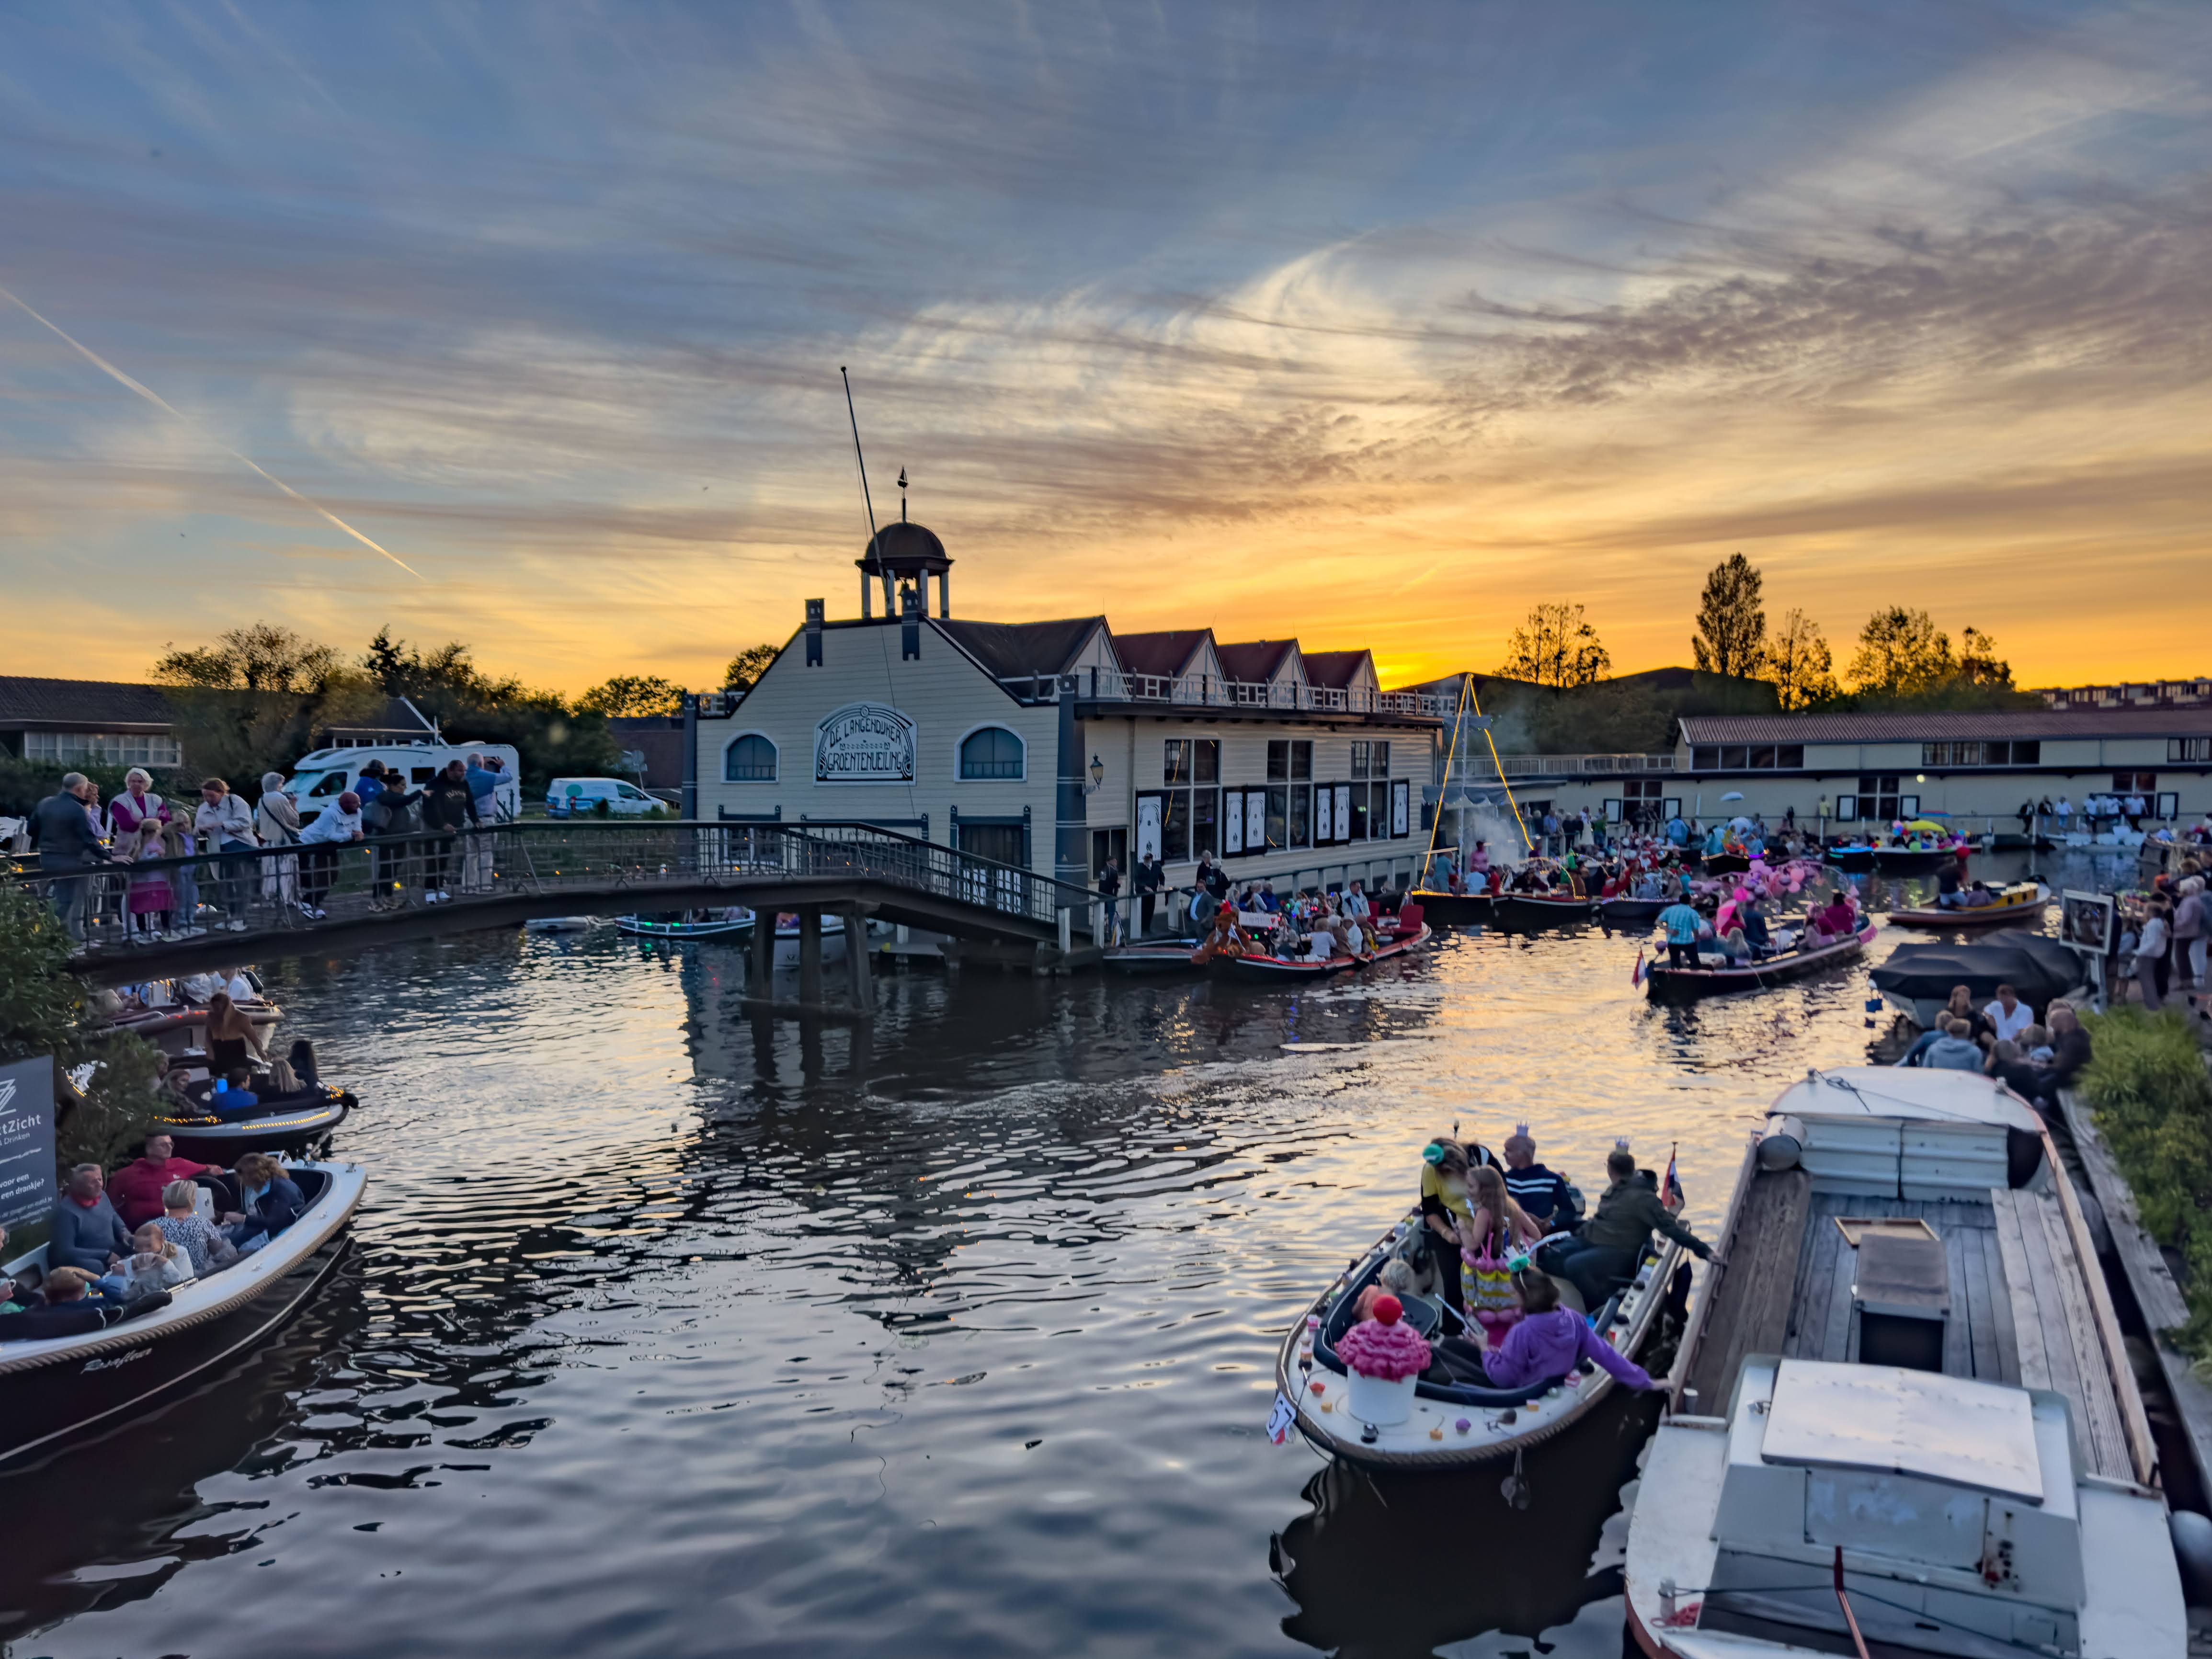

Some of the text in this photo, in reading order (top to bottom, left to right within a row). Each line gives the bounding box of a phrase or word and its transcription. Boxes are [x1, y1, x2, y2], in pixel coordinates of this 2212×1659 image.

[830, 725, 842, 747] DE
[827, 751, 902, 771] GROENTENVEILING
[16, 1173, 29, 1182] een
[0, 1191, 14, 1199] een
